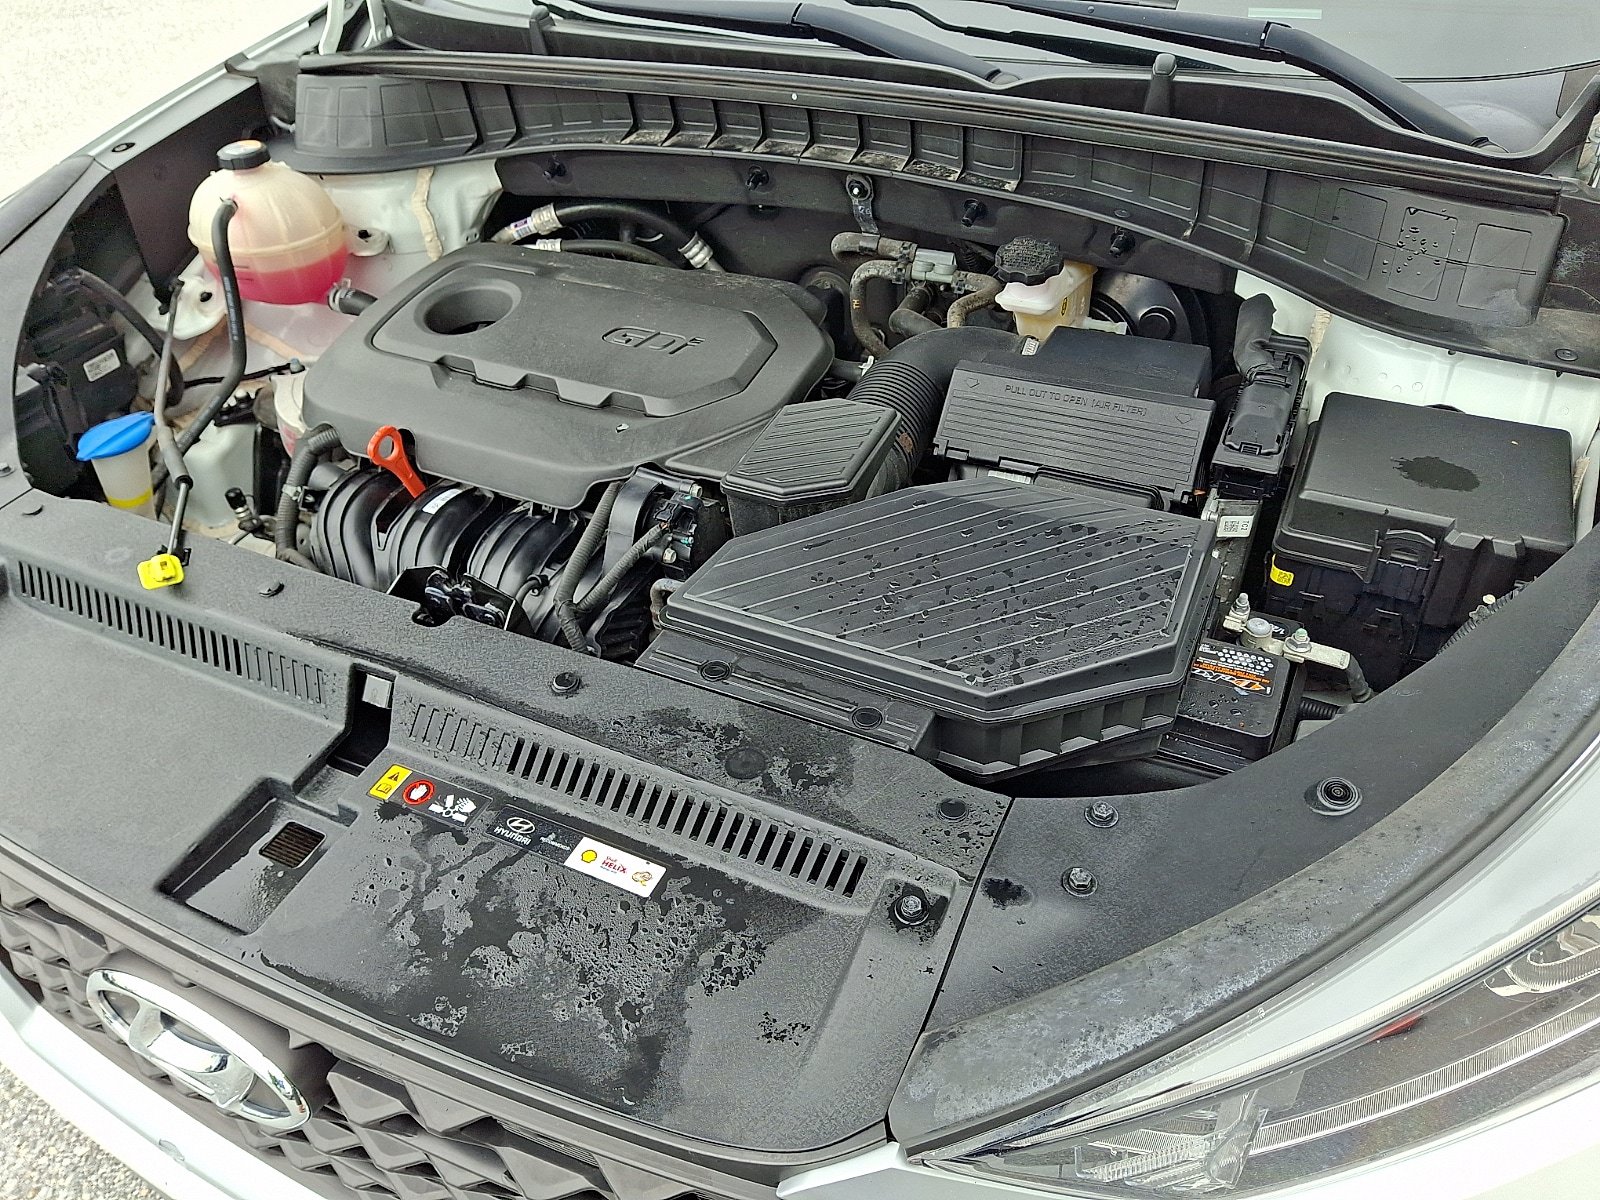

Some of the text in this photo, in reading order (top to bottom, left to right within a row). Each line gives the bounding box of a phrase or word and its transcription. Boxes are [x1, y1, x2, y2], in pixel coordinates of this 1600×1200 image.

[1004, 384, 1027, 396] PULL
[1029, 388, 1047, 399] OUT
[1049, 391, 1061, 401] TO
[1063, 394, 1088, 406] OPEN
[493, 826, 531, 845] HYUNDAI
[601, 859, 628, 875] HELIX
